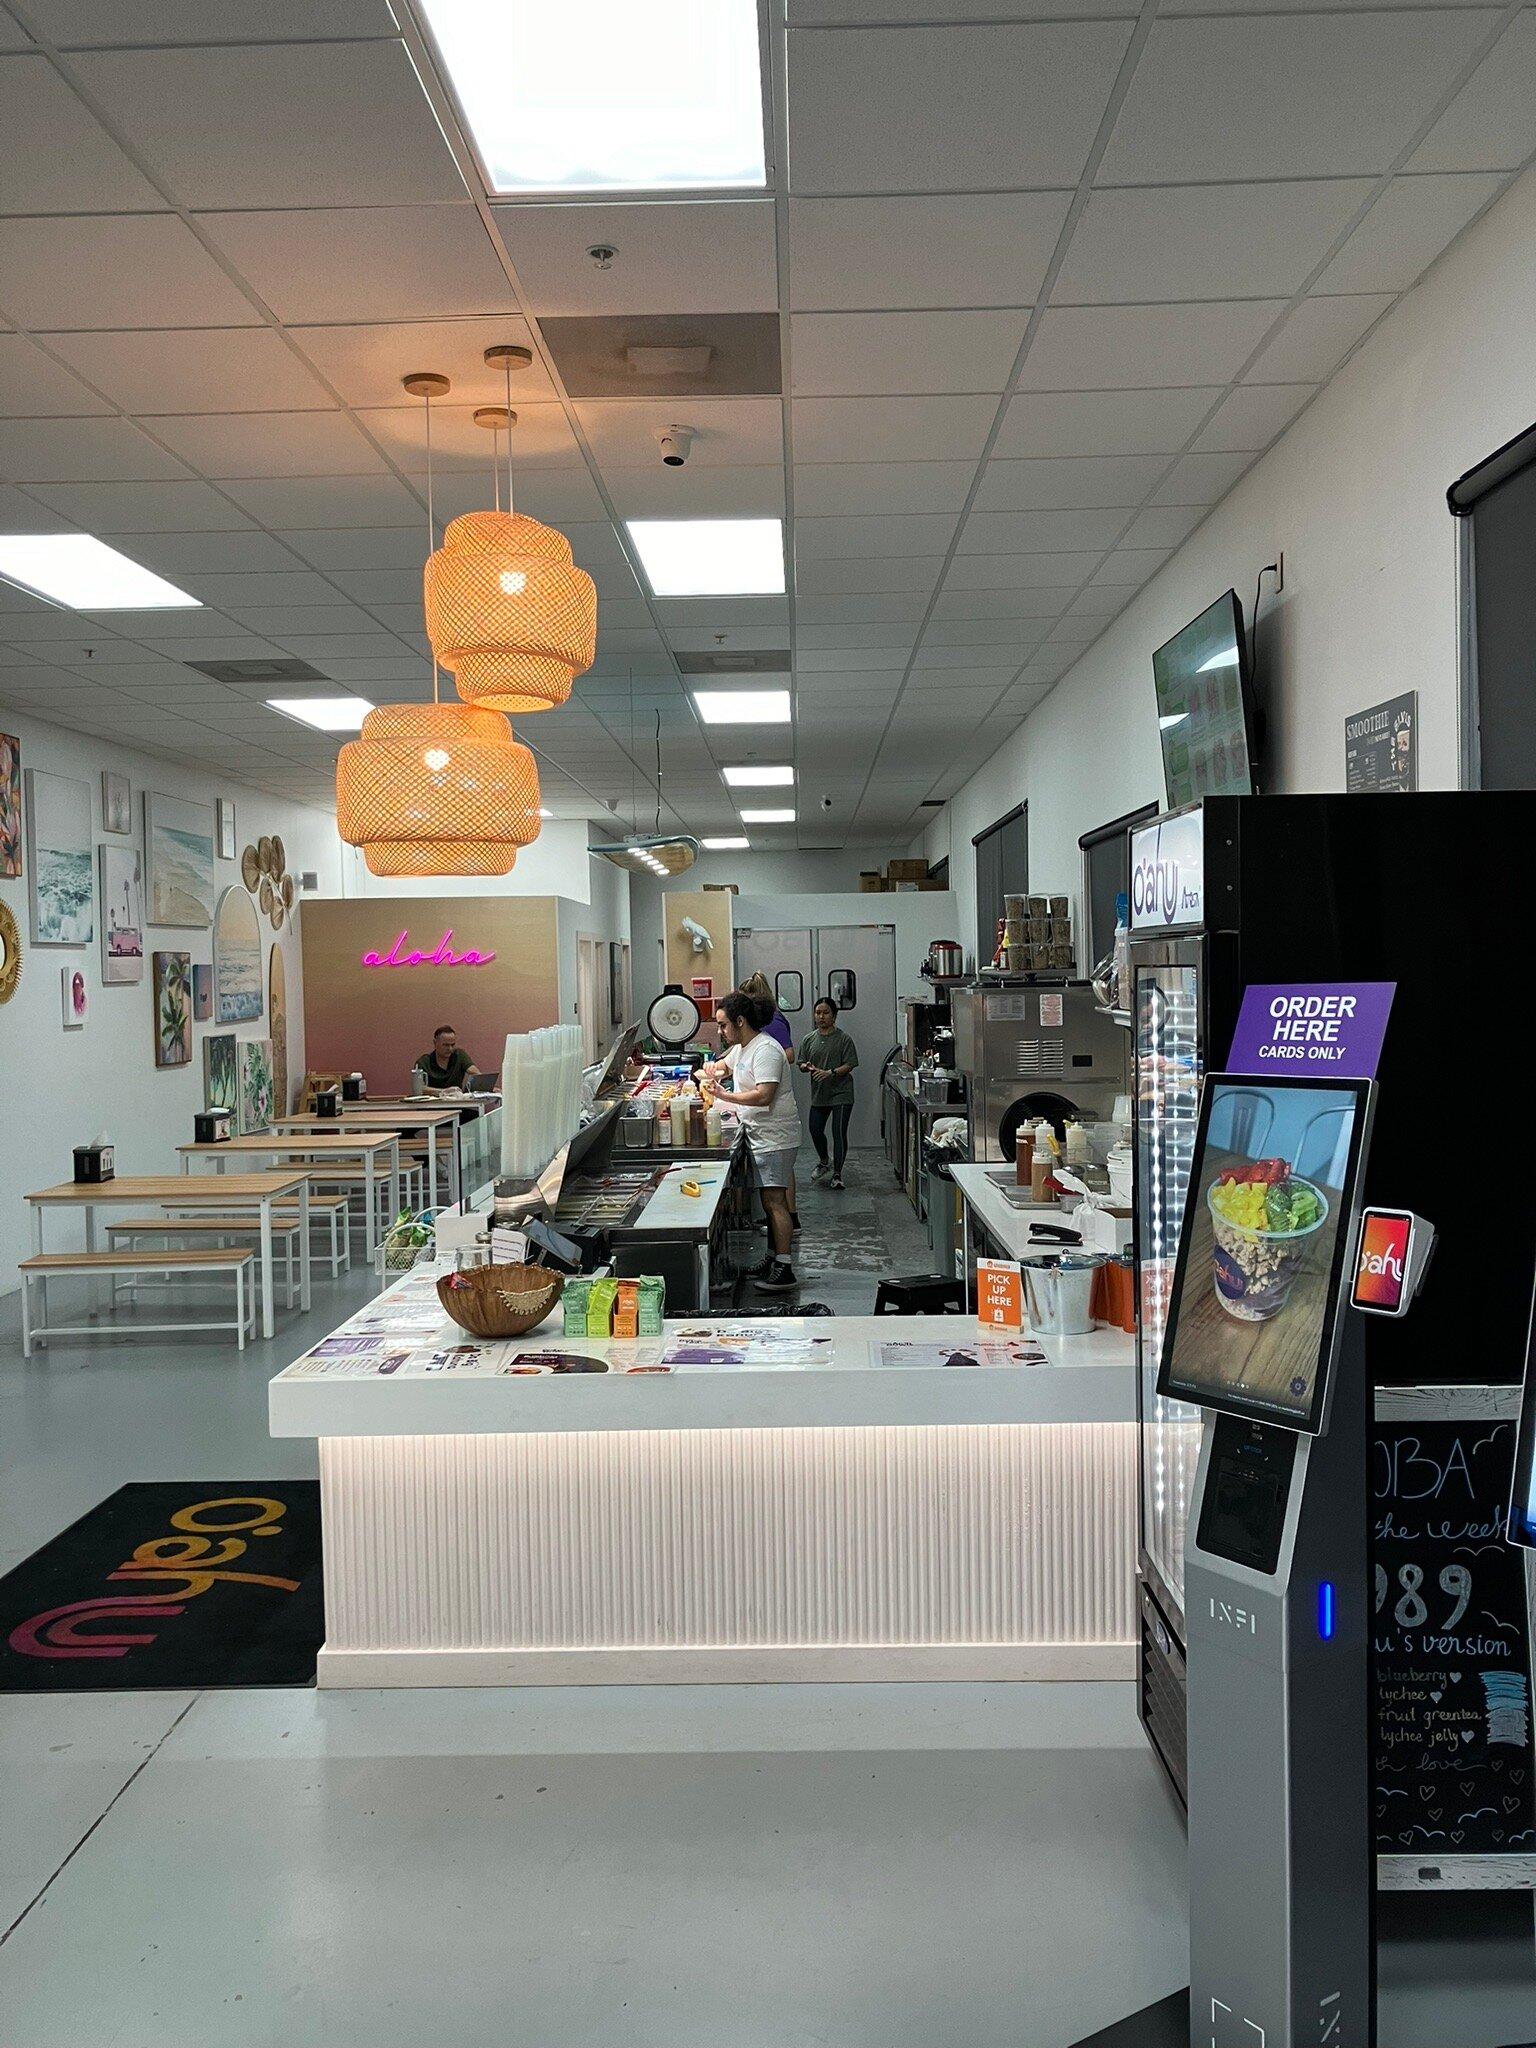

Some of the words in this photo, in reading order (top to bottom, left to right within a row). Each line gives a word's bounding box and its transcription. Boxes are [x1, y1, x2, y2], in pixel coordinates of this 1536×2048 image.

[1346, 711, 1390, 741] SMOOTHIE
[363, 929, 496, 967] aloha
[1269, 996, 1357, 1018] ORDER
[1272, 1020, 1342, 1042] HERE
[1258, 1046, 1305, 1059] CARDS
[1308, 1046, 1346, 1060] ONLY
[987, 1273, 1011, 1285] PICK
[987, 1295, 1012, 1306] HERE
[992, 1285, 1007, 1295] UP
[1423, 1635, 1511, 1656] version
[1376, 1667, 1447, 1690] blueberry
[1379, 1686, 1427, 1707] lychee
[1378, 1707, 1416, 1722] fruit
[1381, 1727, 1423, 1748] lychee
[1428, 1728, 1459, 1752] jelly
[1416, 1753, 1488, 1772] love
